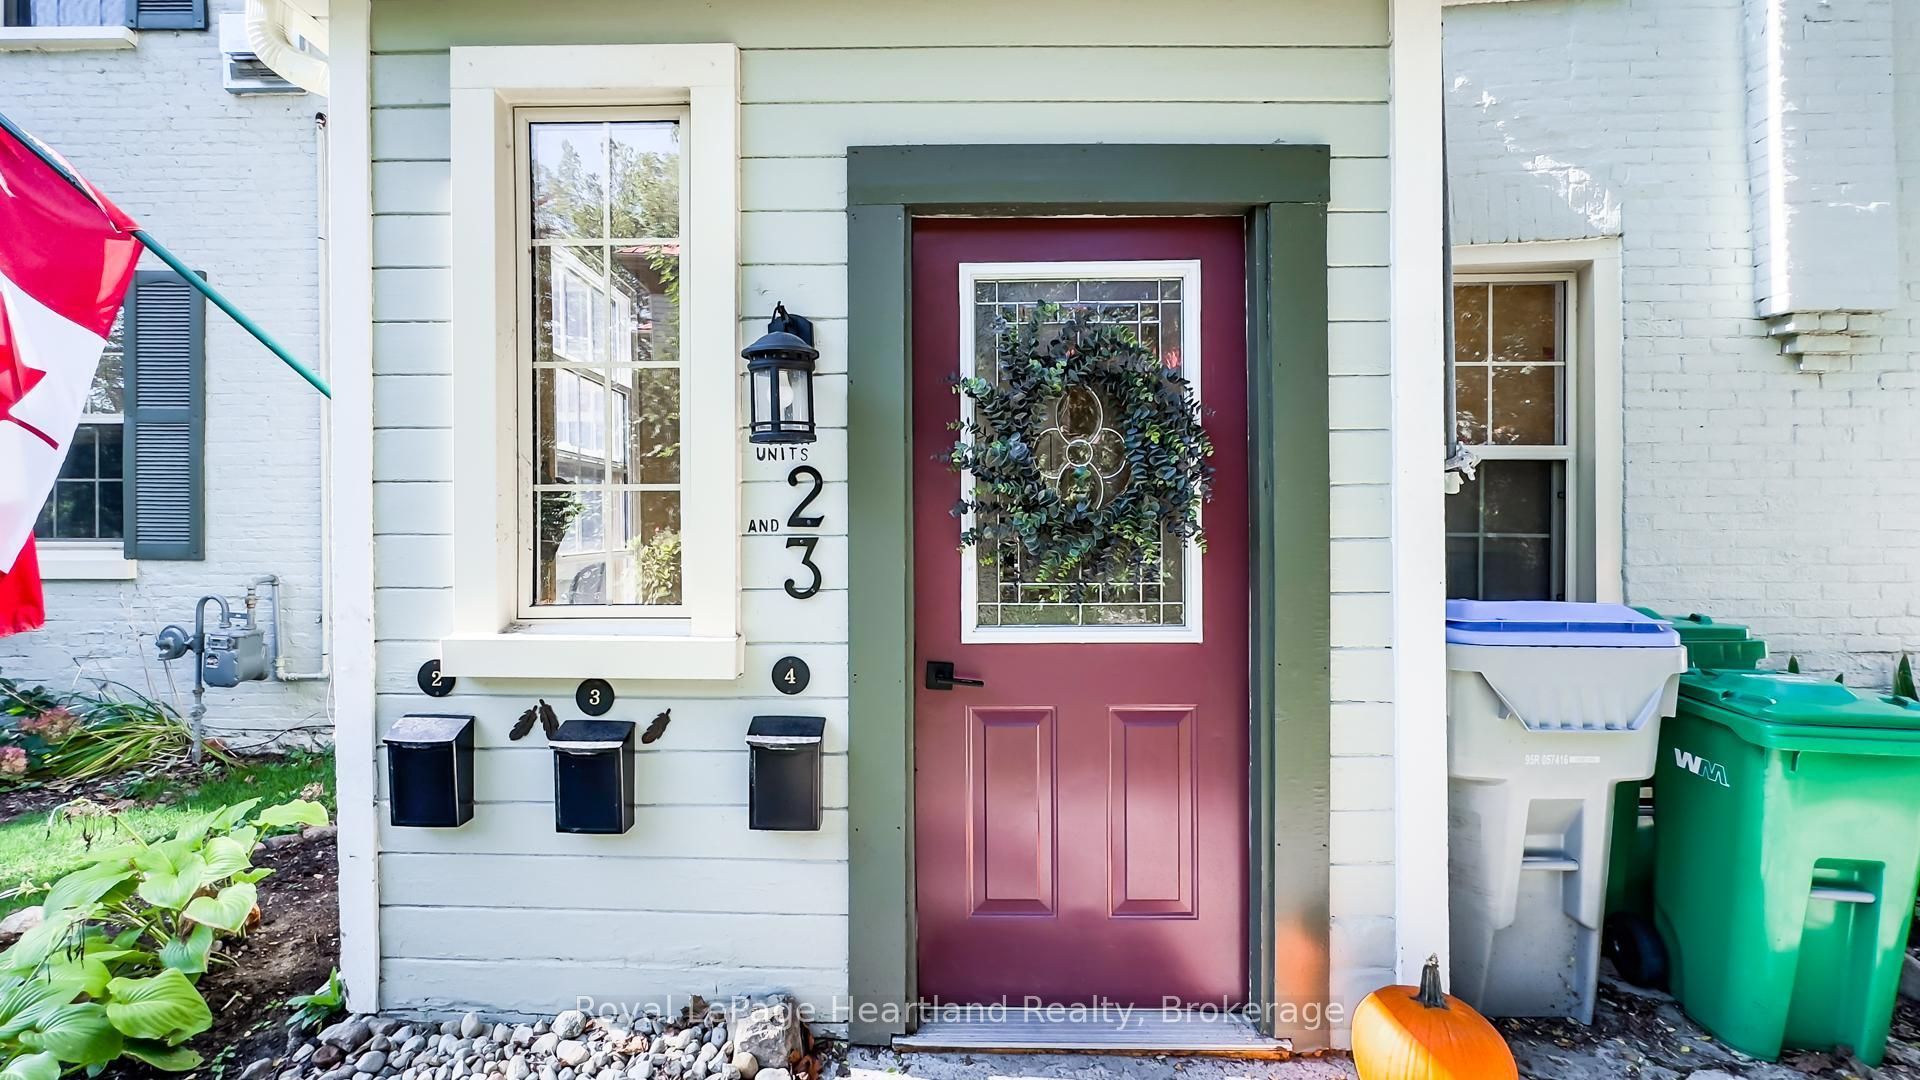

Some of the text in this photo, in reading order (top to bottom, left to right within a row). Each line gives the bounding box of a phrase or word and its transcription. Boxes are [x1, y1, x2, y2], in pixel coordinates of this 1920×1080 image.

[756, 447, 809, 461] UNITS
[787, 465, 825, 527] 2
[748, 519, 779, 532] AND
[784, 537, 822, 599] 3
[431, 670, 442, 687] 2
[784, 668, 796, 684] 4
[589, 689, 600, 705] 3
[1674, 747, 1730, 788] WM
